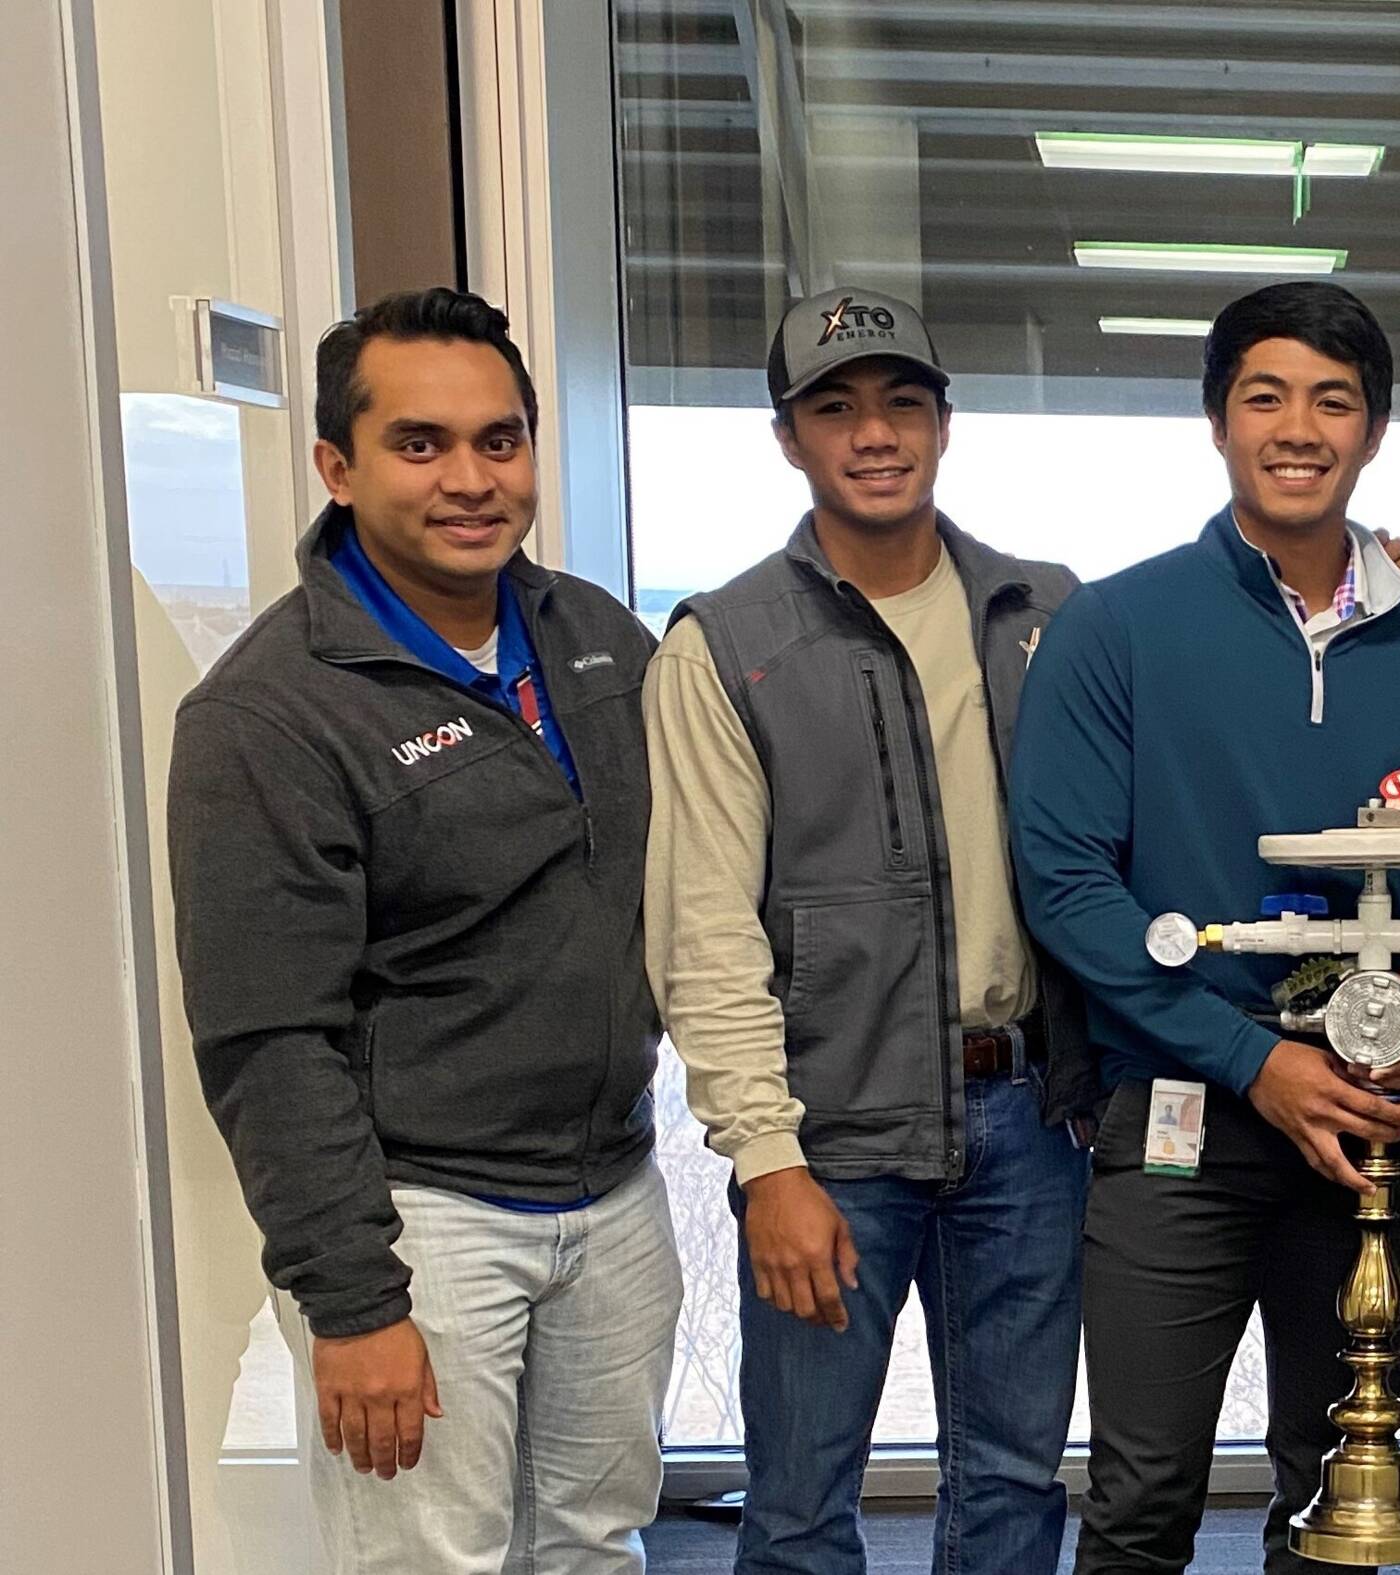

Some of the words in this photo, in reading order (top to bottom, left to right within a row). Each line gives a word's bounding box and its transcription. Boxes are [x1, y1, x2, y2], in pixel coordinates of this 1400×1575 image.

[817, 297, 894, 346] XTO
[837, 329, 896, 341] ENERGY
[391, 716, 473, 766] UNCON
